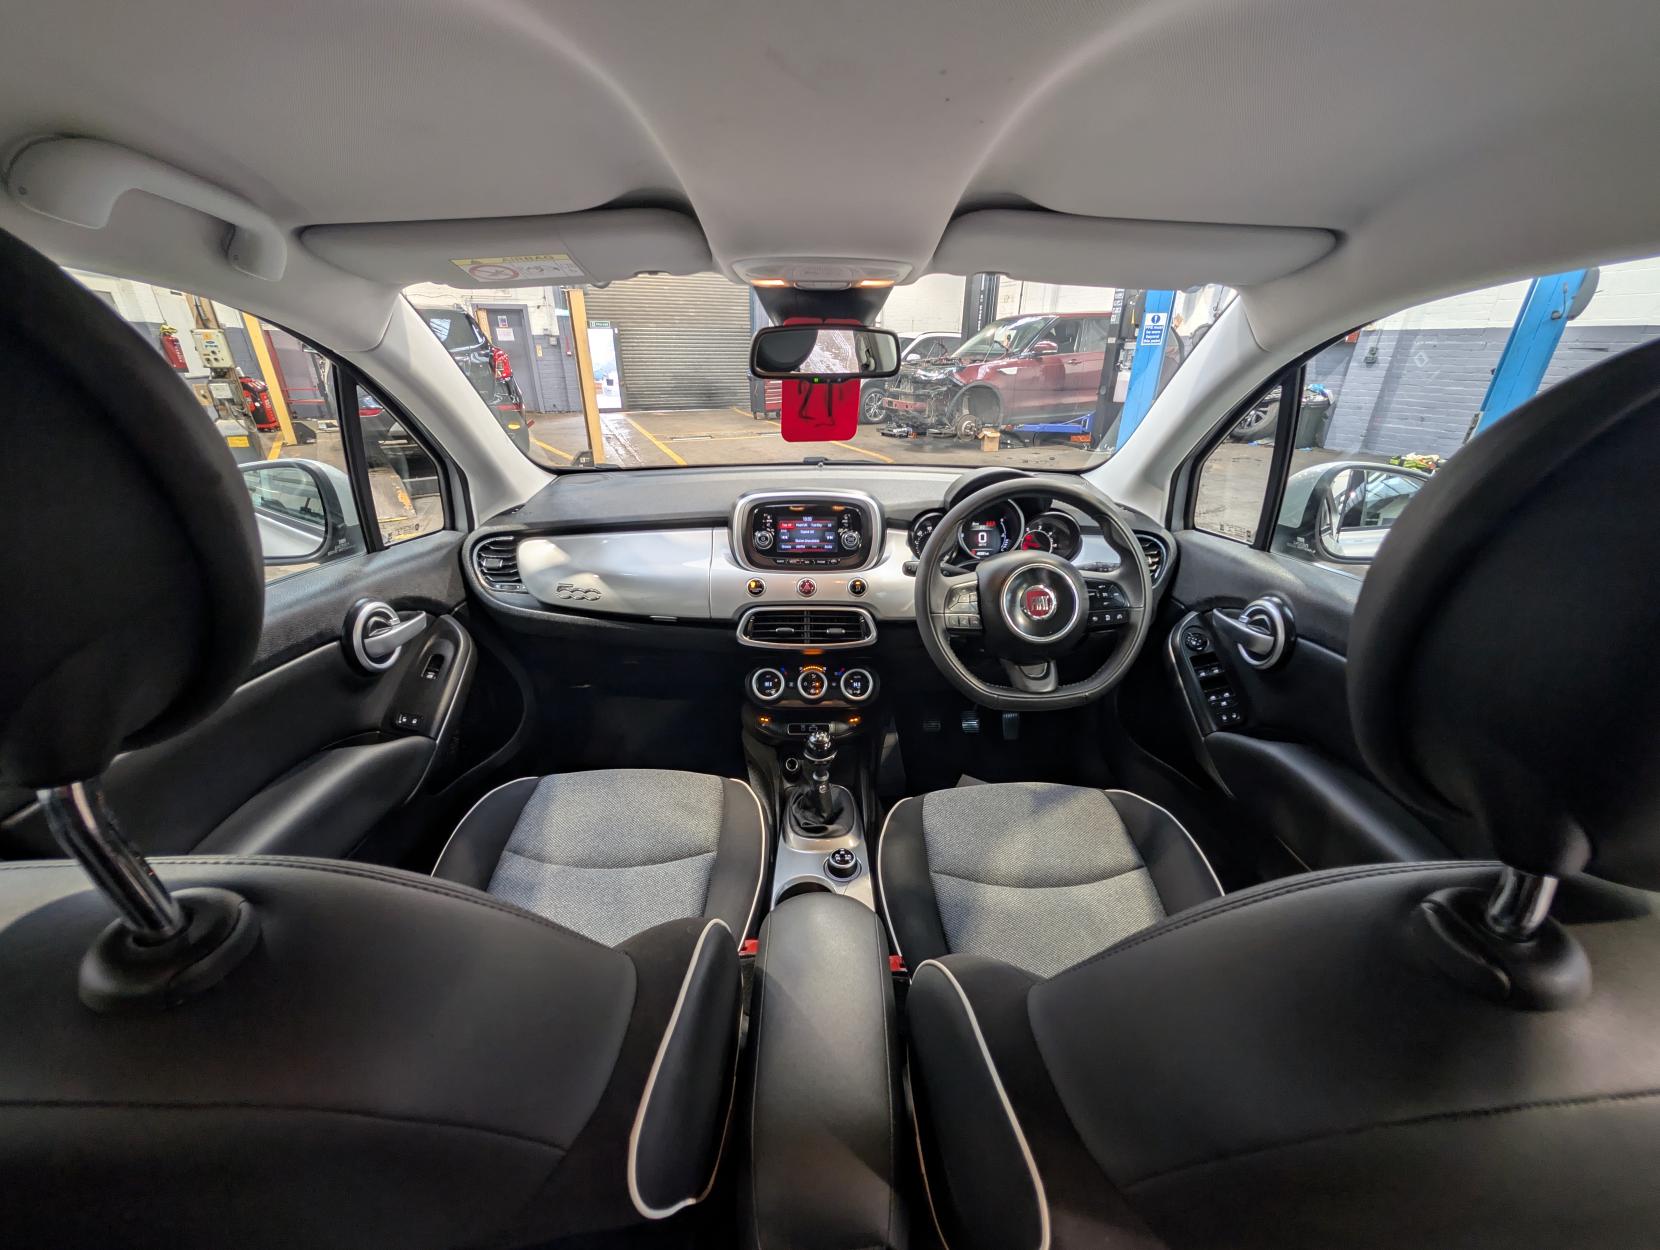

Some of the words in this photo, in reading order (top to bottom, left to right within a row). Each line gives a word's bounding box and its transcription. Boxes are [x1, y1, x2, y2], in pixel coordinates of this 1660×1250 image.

[978, 531, 987, 543] 0
[556, 582, 603, 602] 500
[1031, 595, 1049, 611] FIAT
